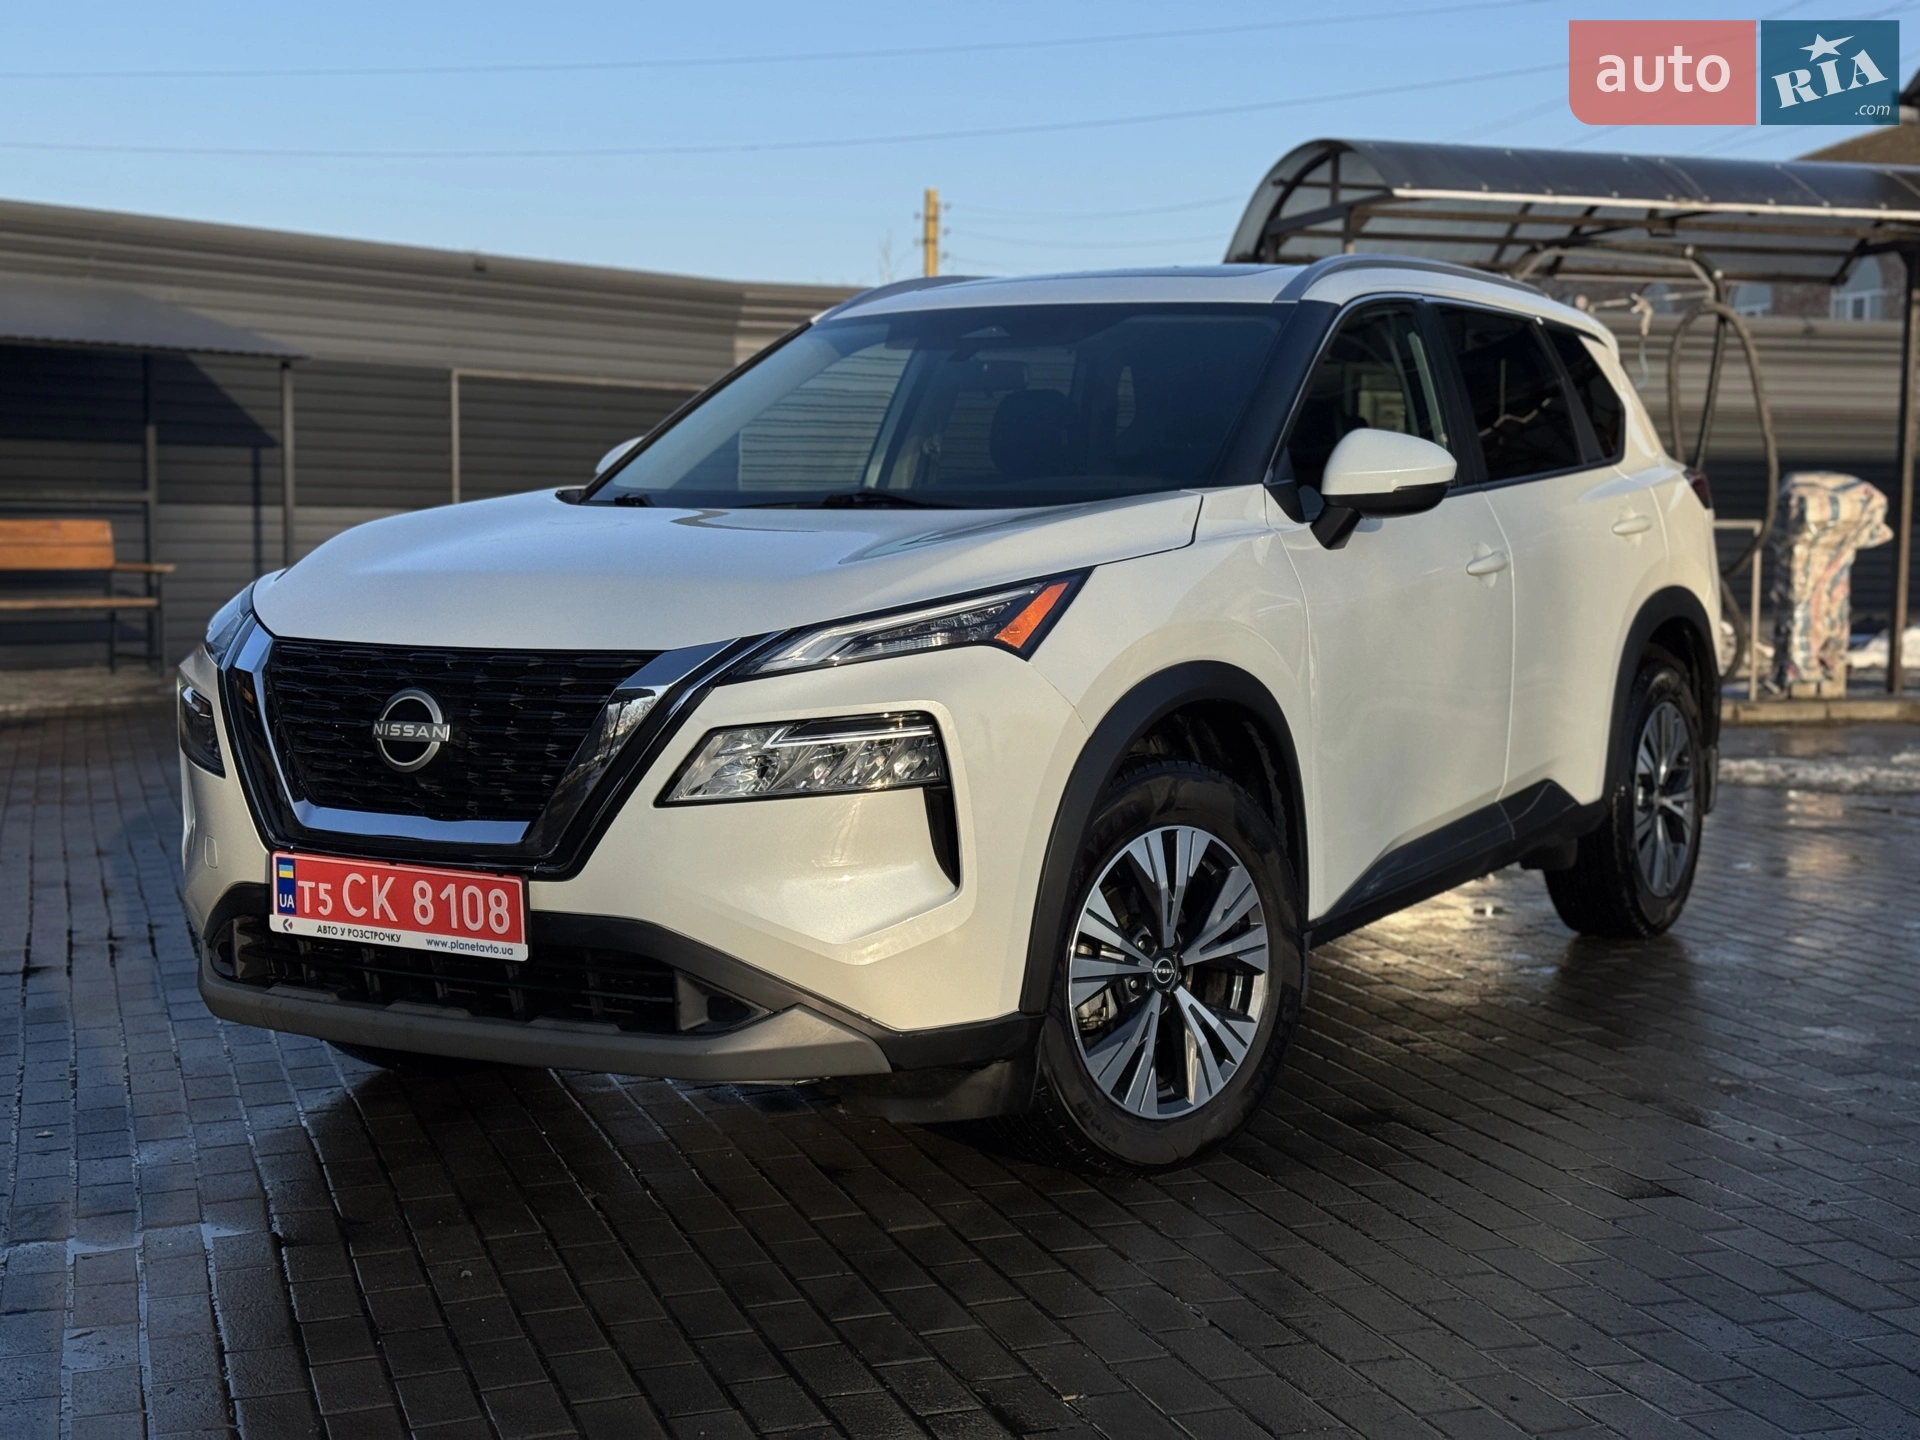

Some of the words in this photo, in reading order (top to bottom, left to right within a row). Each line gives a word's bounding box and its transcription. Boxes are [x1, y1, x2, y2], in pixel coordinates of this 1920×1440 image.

[373, 723, 446, 738] NISSAN
[279, 893, 295, 909] UA
[298, 880, 333, 916] T5
[343, 872, 398, 922] CK
[413, 880, 510, 934] 8108
[317, 925, 338, 935] АВТО
[340, 927, 346, 937] У
[348, 928, 401, 943] РОЗСТРОЧКУ
[426, 938, 513, 956] www.planetavto.ua
